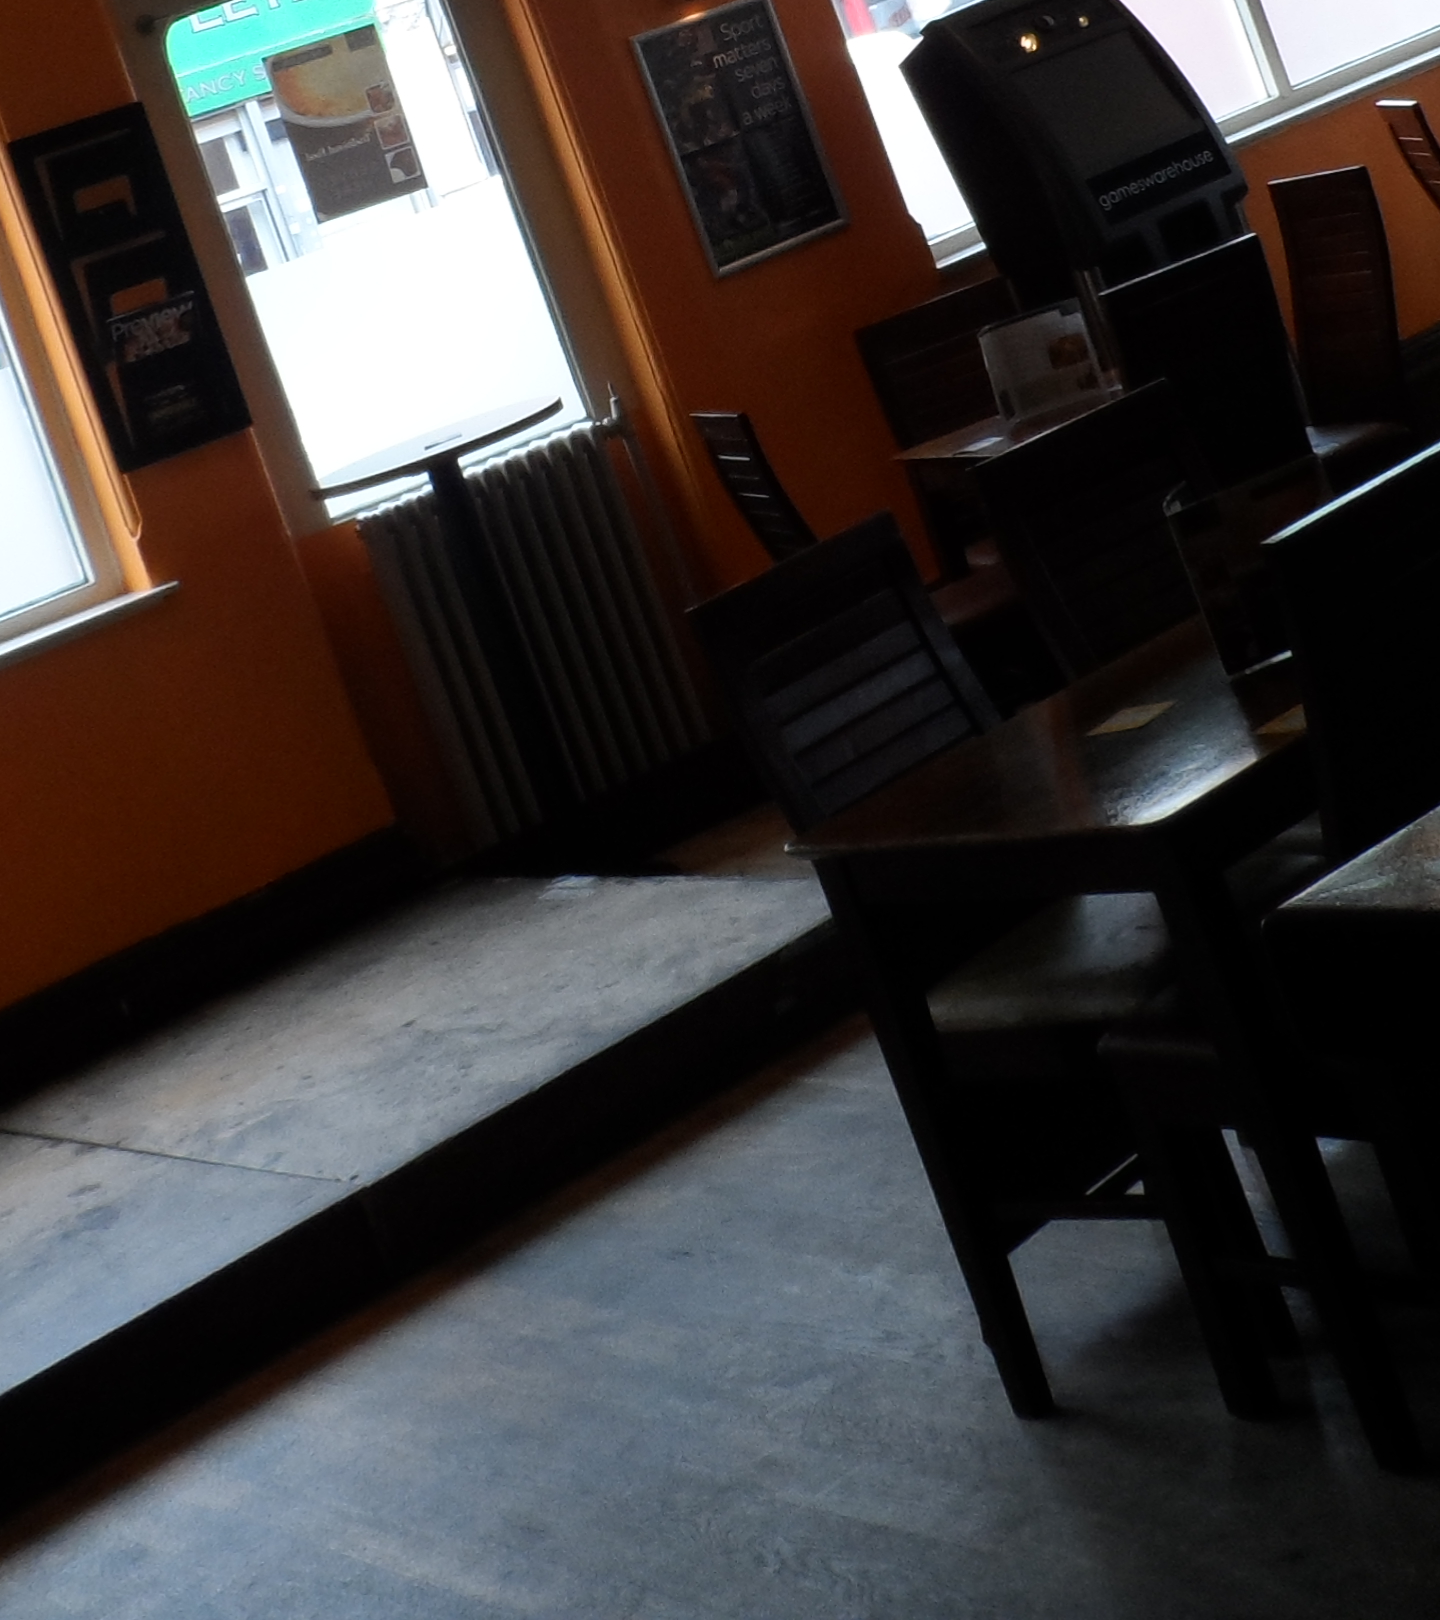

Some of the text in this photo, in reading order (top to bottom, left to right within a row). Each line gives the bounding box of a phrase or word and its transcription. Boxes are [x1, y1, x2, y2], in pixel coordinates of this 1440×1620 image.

[720, 14, 764, 42] Sport
[713, 37, 772, 69] matters
[184, 68, 247, 103] ANCY
[734, 56, 779, 83] seven
[751, 76, 786, 99] days
[742, 94, 793, 126] a week
[110, 300, 193, 343] Preview
